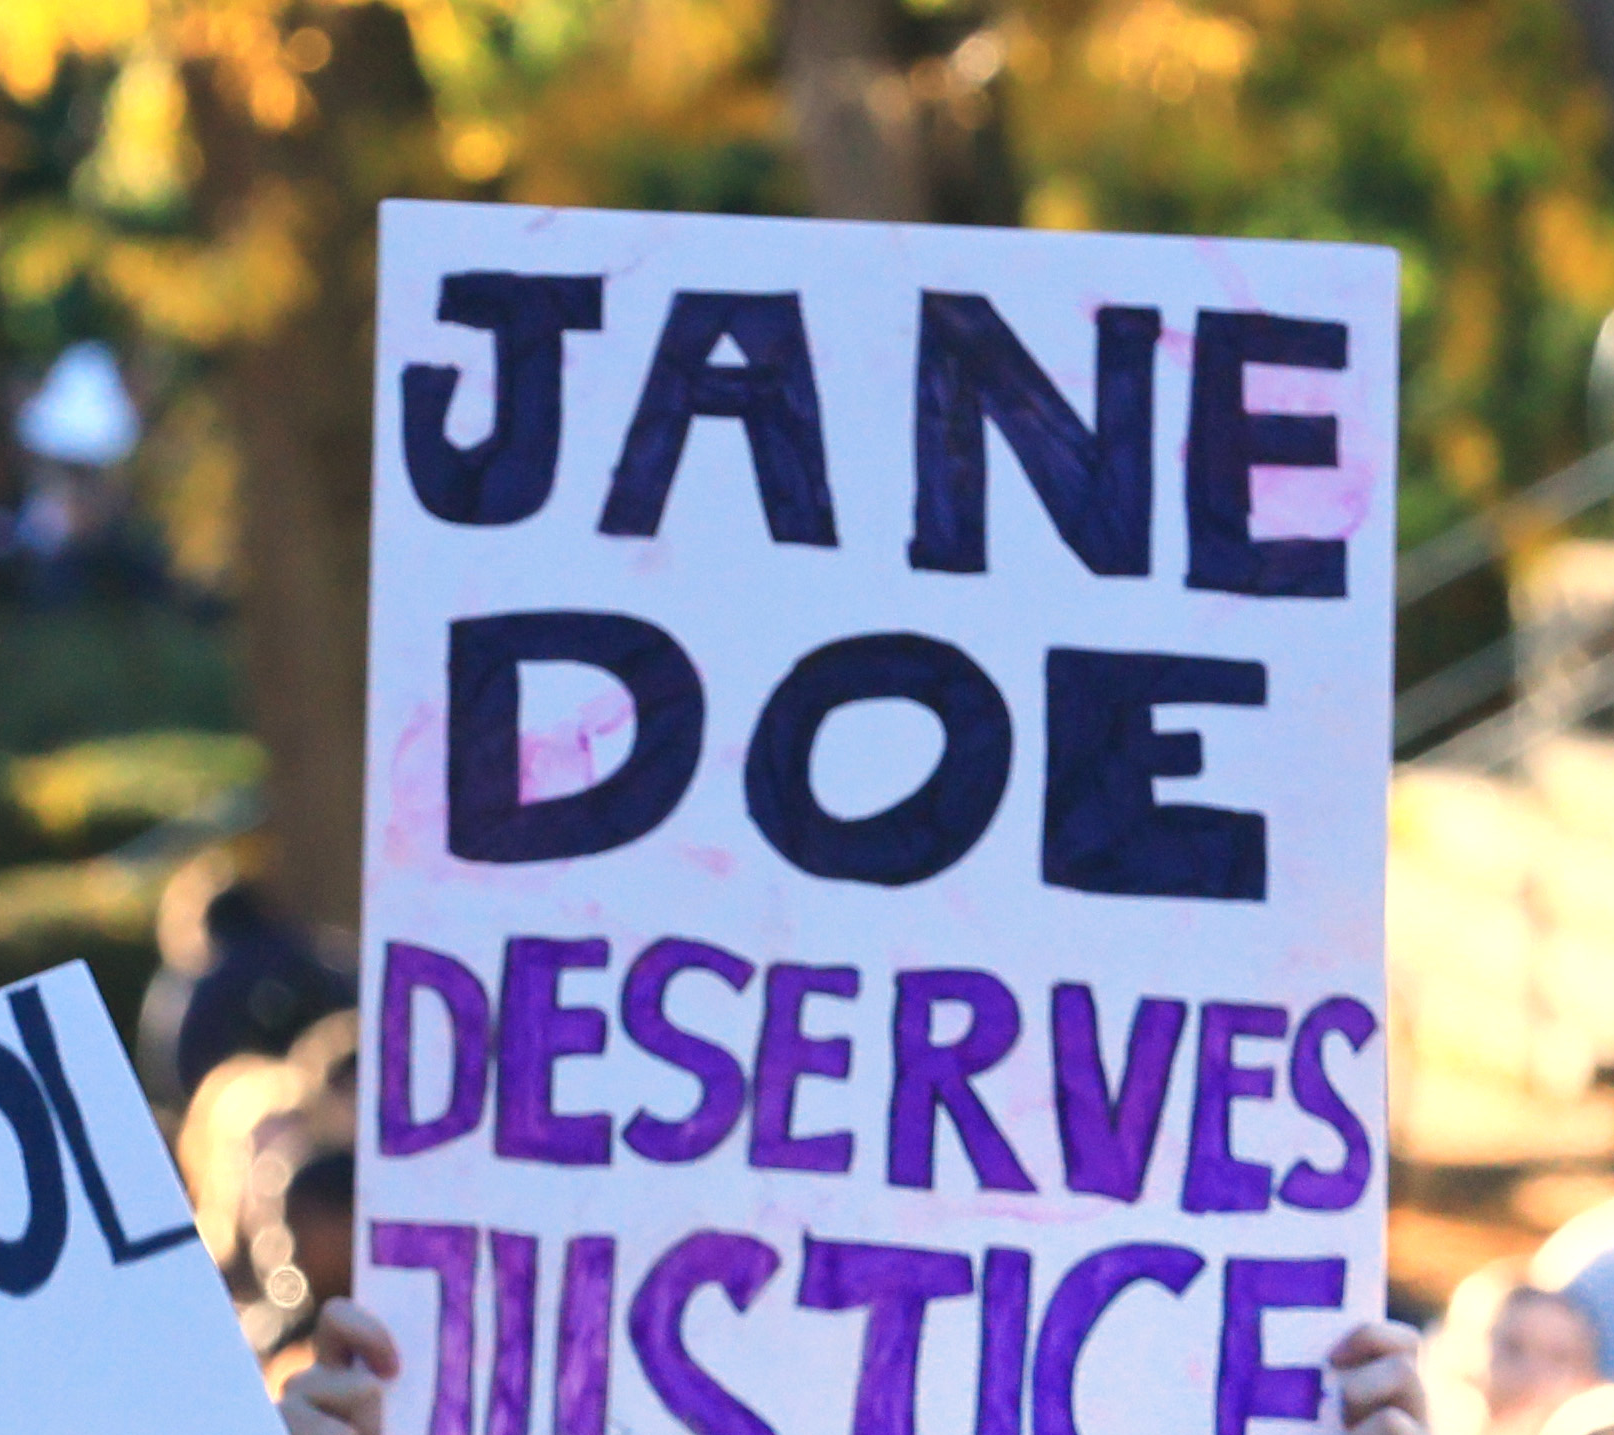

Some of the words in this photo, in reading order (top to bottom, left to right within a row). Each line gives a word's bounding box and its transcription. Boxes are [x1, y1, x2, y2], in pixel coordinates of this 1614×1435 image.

[400, 270, 1349, 599] JANE
[446, 609, 1268, 903] DOE
[376, 935, 1379, 1213] DESERVES
